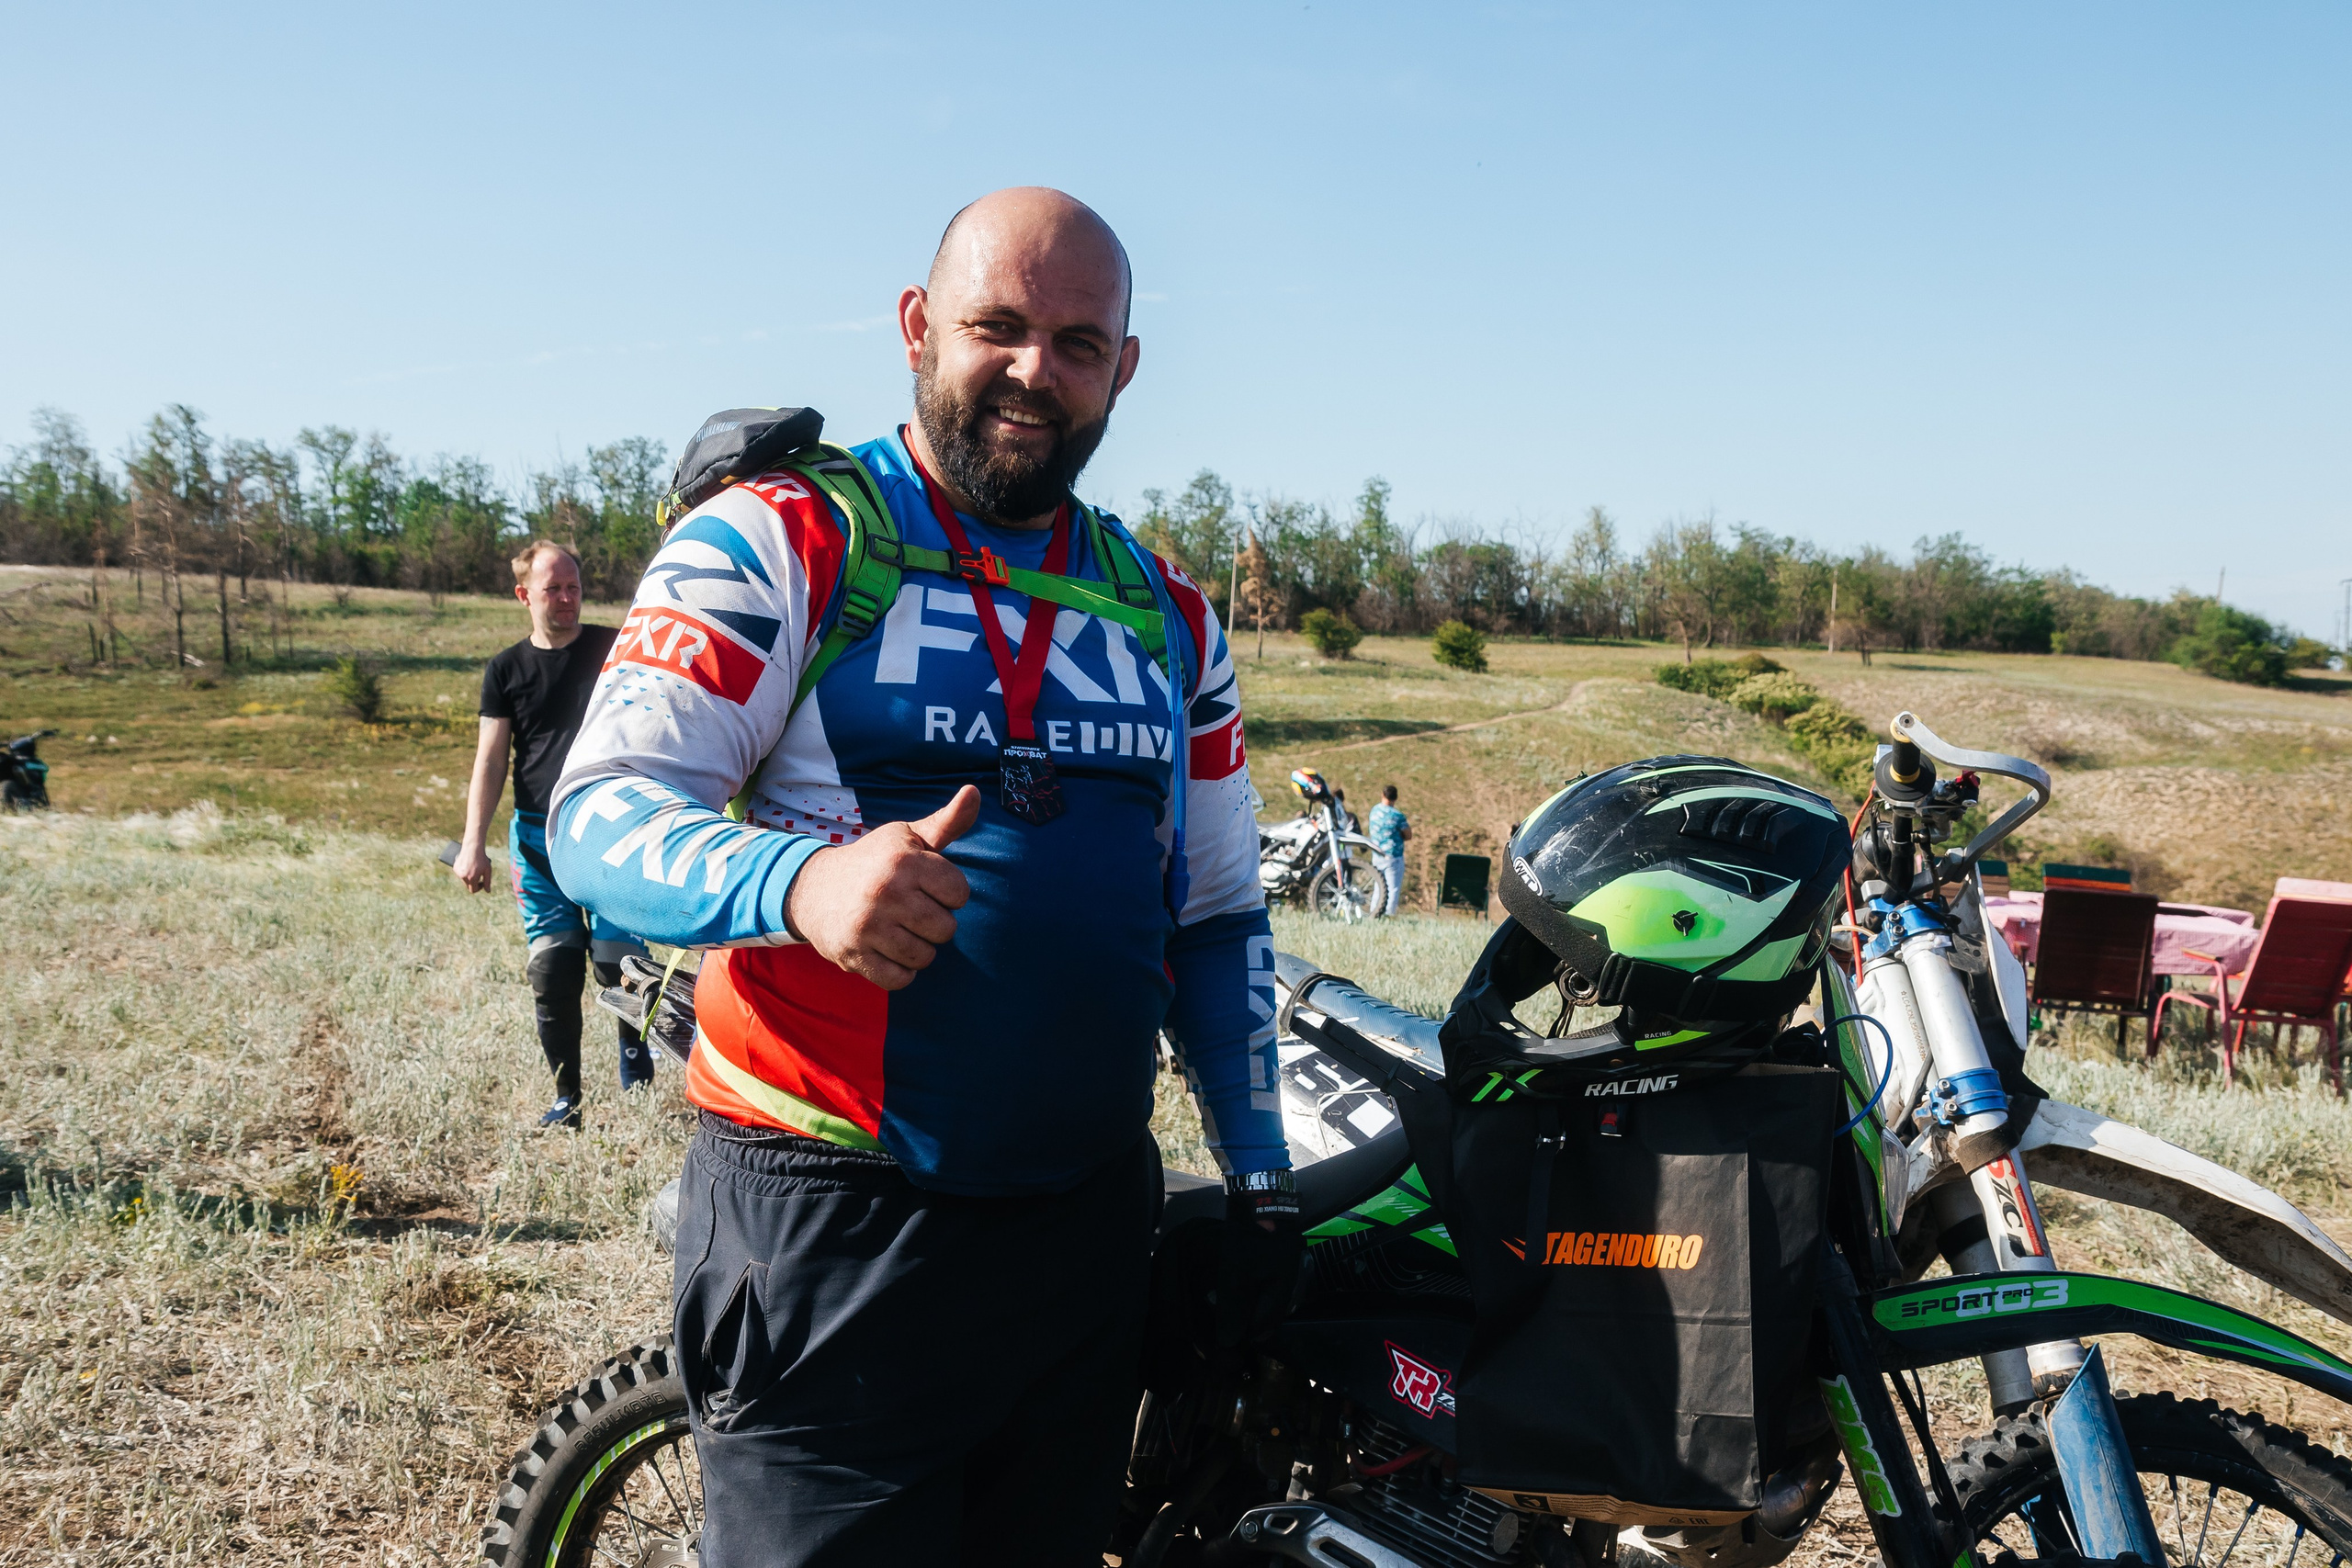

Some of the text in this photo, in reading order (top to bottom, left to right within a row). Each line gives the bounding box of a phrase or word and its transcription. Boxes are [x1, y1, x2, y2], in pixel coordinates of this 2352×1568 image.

[606, 615, 709, 670] FXR
[925, 705, 1074, 753] RAE
[1644, 1031, 1672, 1040] RACING
[1584, 1074, 1679, 1097] RACING
[1901, 1288, 2034, 1318] SPORT PRO
[573, 1391, 666, 1452] REGULMOTO
